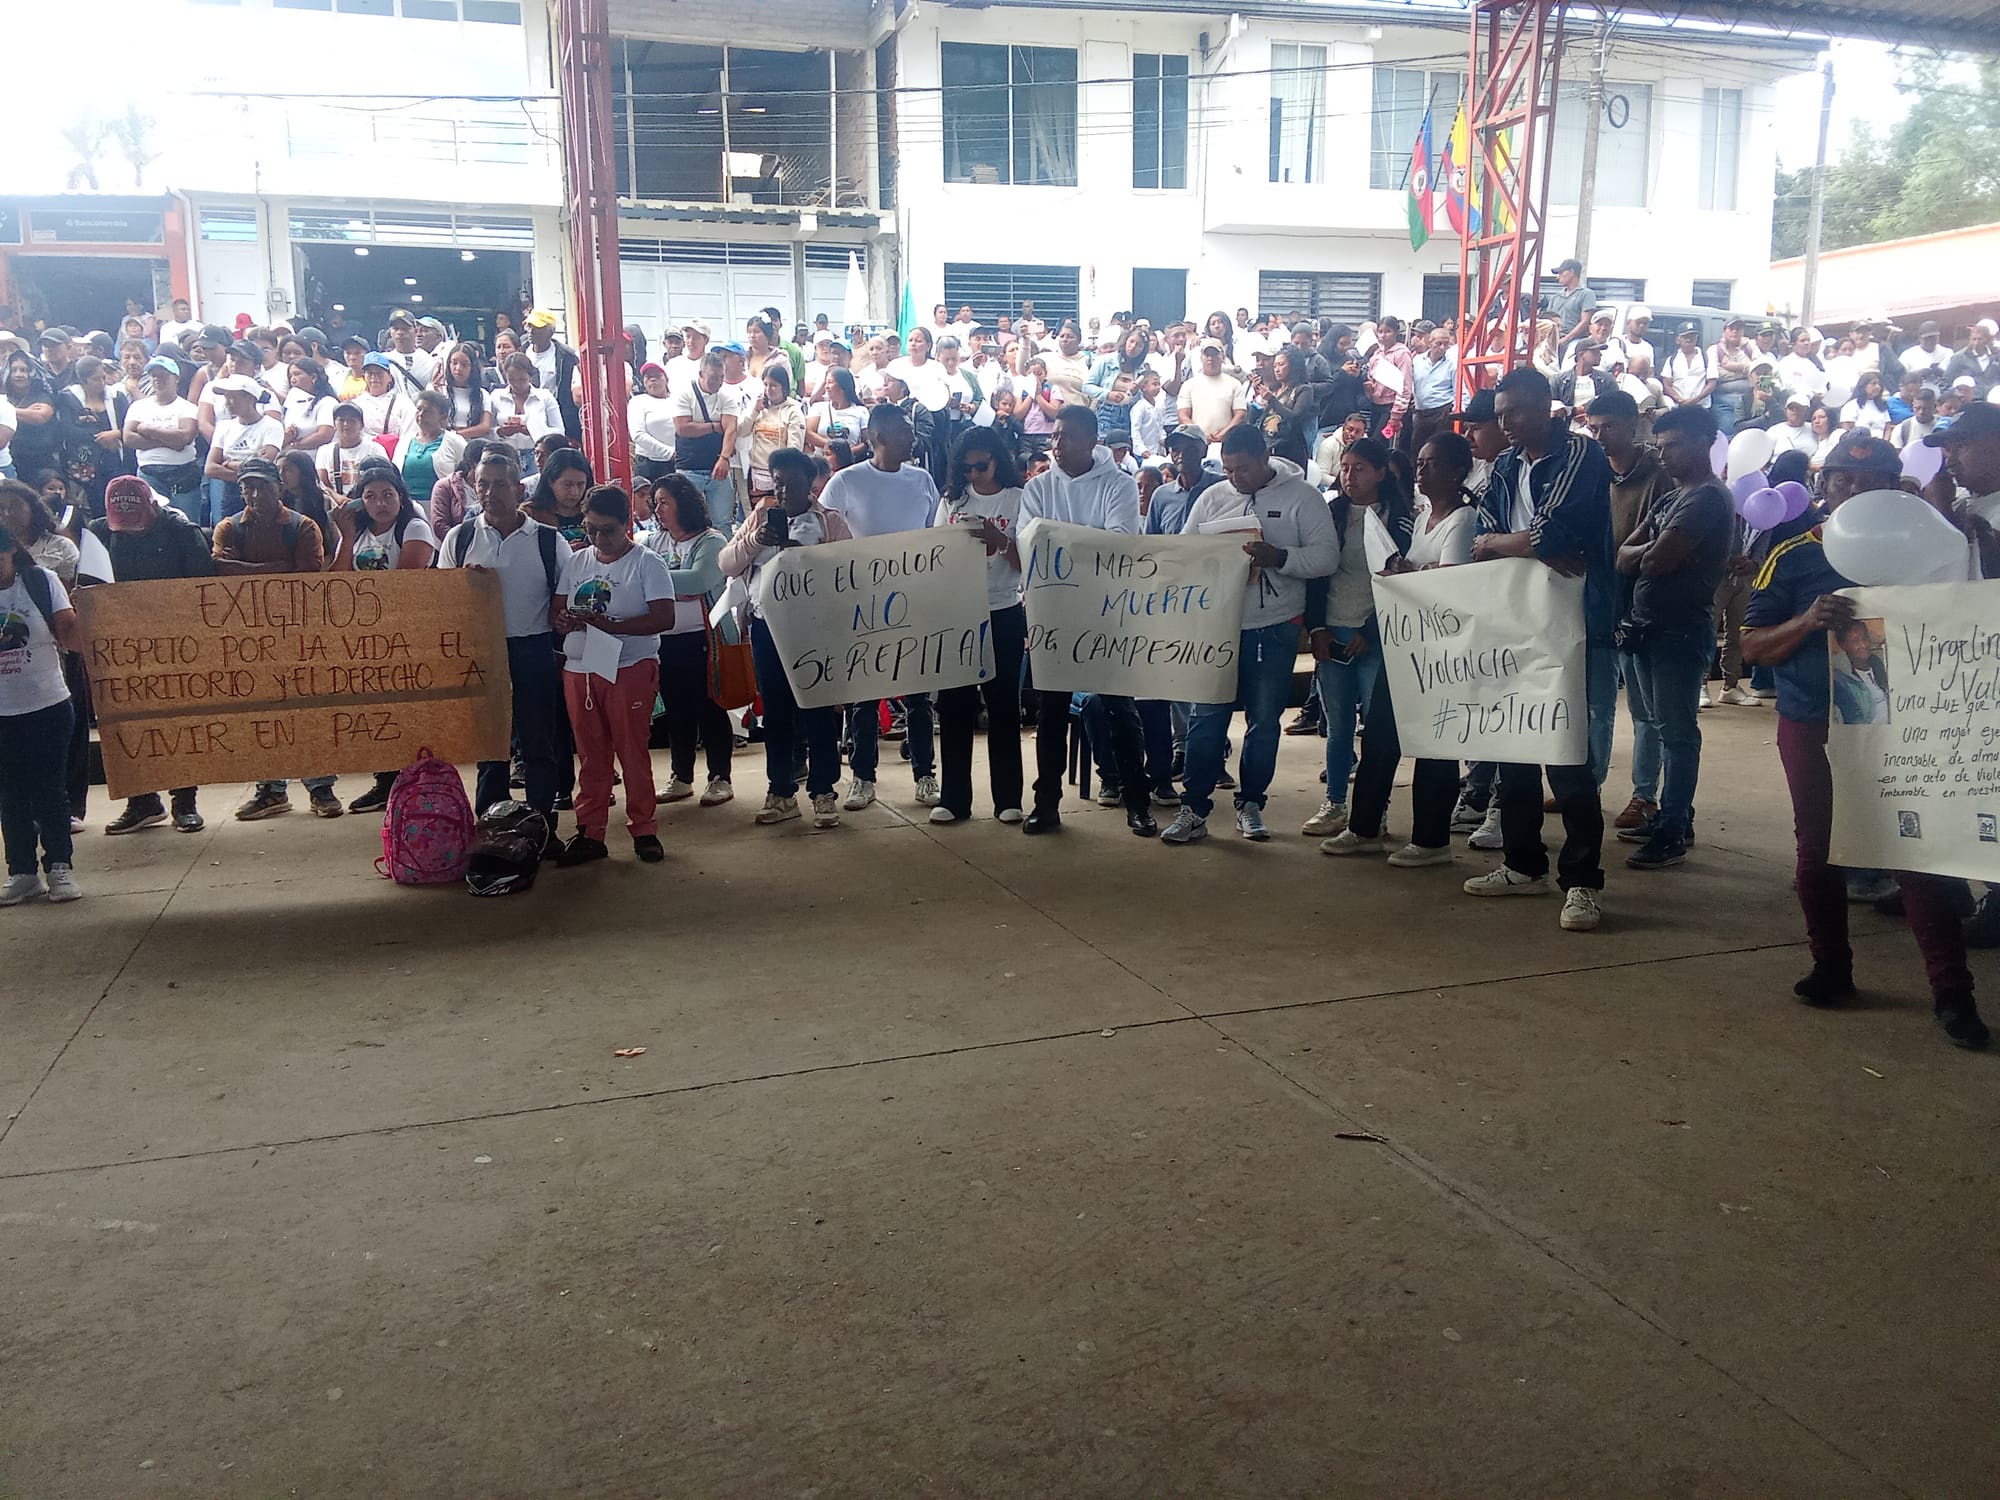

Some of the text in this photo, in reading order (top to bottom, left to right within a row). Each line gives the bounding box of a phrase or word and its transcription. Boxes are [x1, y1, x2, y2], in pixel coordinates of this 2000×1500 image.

[773, 569, 815, 601] QUE
[868, 545, 945, 586] DOLOR
[1026, 539, 1158, 590] NO MAS
[195, 578, 382, 638] EXIGIMOS
[853, 591, 908, 631] NO
[1101, 584, 1211, 627] MUERTE
[1384, 603, 1412, 647] NO
[92, 631, 470, 670] RESPETO POR LA VIDA EL
[793, 619, 989, 690] SE REPITA!
[1028, 624, 1234, 668] DE CAMPESINOS
[1903, 623, 2000, 690] Virgelin
[96, 669, 254, 704] TERRITORIO
[328, 662, 433, 695] DERECHO
[459, 660, 486, 687] A
[1410, 648, 1519, 694] VIOLENCIA
[1962, 667, 2000, 703] Val
[116, 711, 401, 760] VIVIR EN PAZ
[1432, 692, 1569, 743] #JUSTICIA
[1965, 700, 1989, 728] que
[1981, 726, 2000, 746] eje
[1884, 753, 1938, 767] incansable
[1949, 750, 1965, 764] de
[1905, 774, 1918, 783] un
[1923, 769, 1946, 783] acto
[1955, 767, 1969, 783] de
[1943, 790, 1956, 798] en
